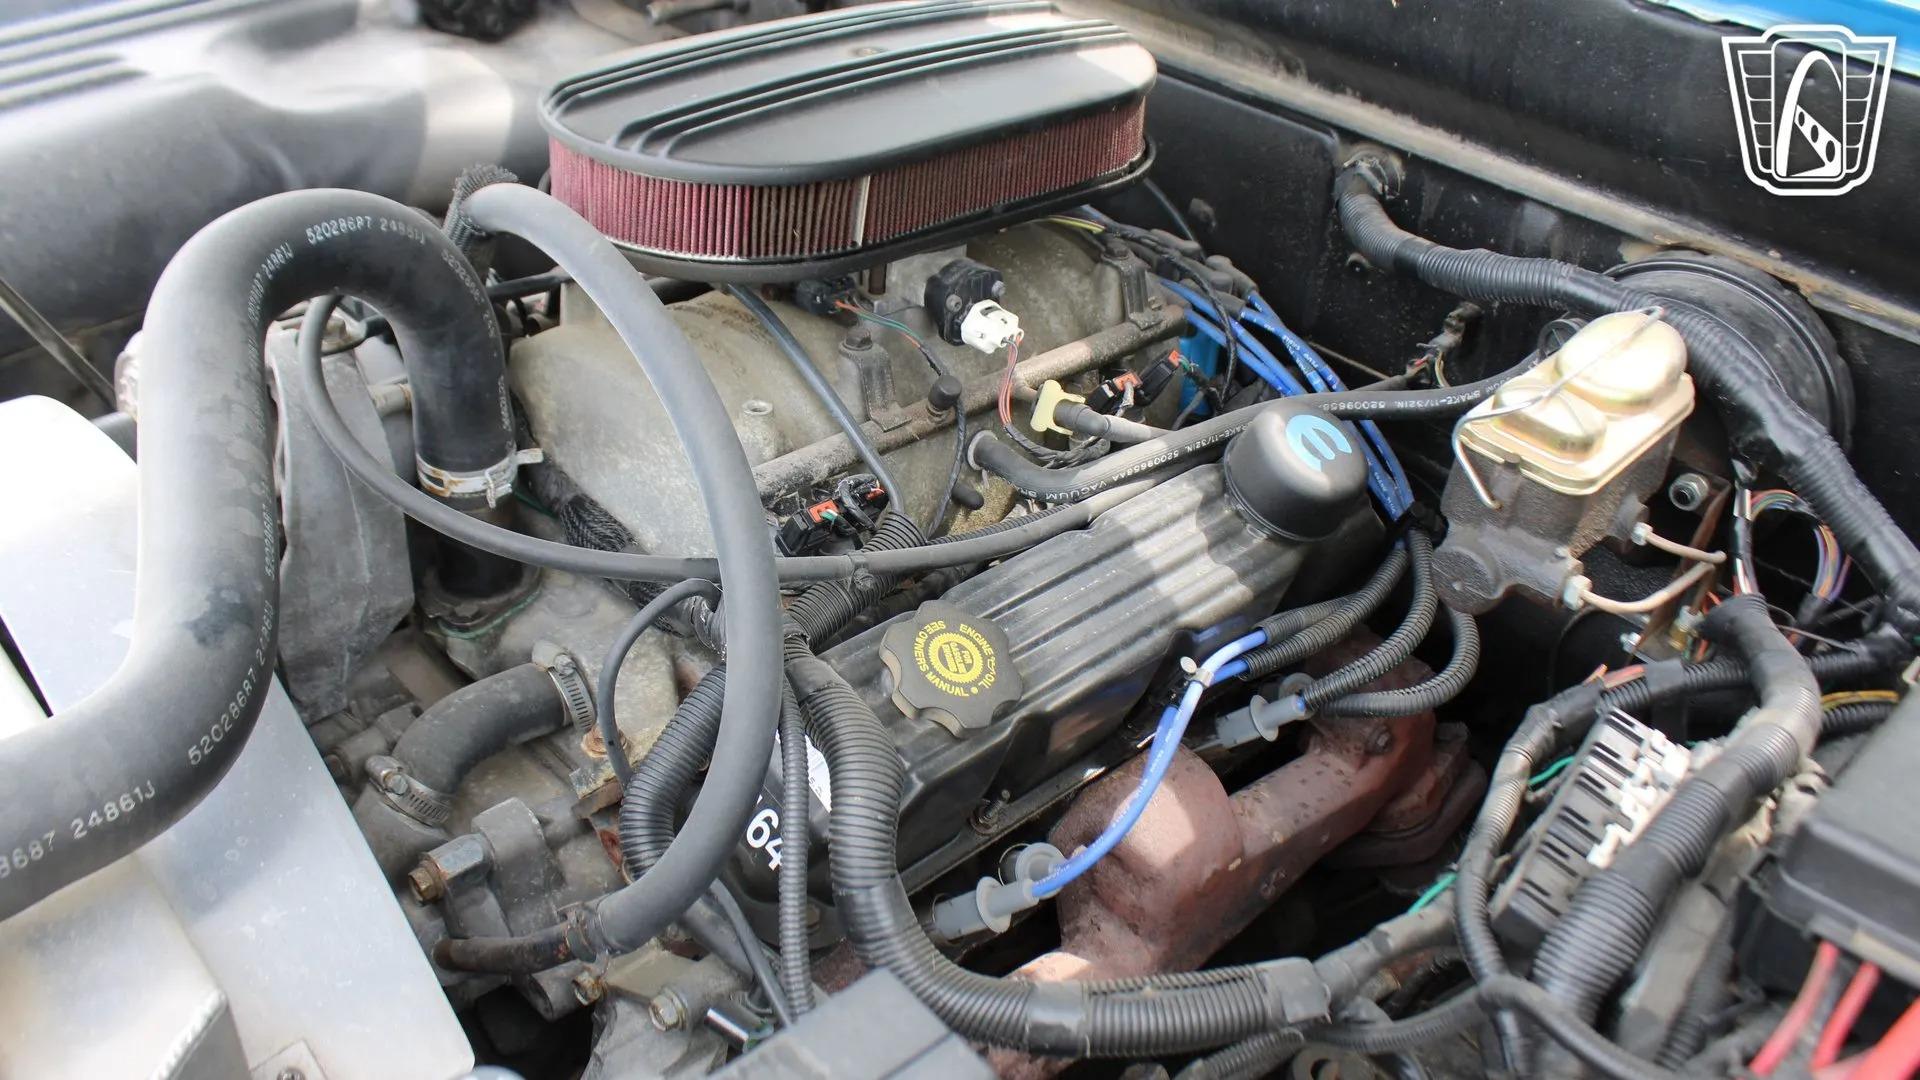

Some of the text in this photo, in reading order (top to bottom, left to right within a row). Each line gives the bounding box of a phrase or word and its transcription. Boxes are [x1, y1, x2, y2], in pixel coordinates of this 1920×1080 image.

[306, 216, 373, 246] 52028687
[1318, 400, 1386, 412] 52009658
[1045, 479, 1107, 500] VACUUM
[924, 620, 946, 635] SEE
[959, 623, 996, 689] ENGINE OIL
[925, 671, 970, 697] MANUAL
[187, 668, 257, 767] 52028687
[70, 780, 156, 839] 24861J
